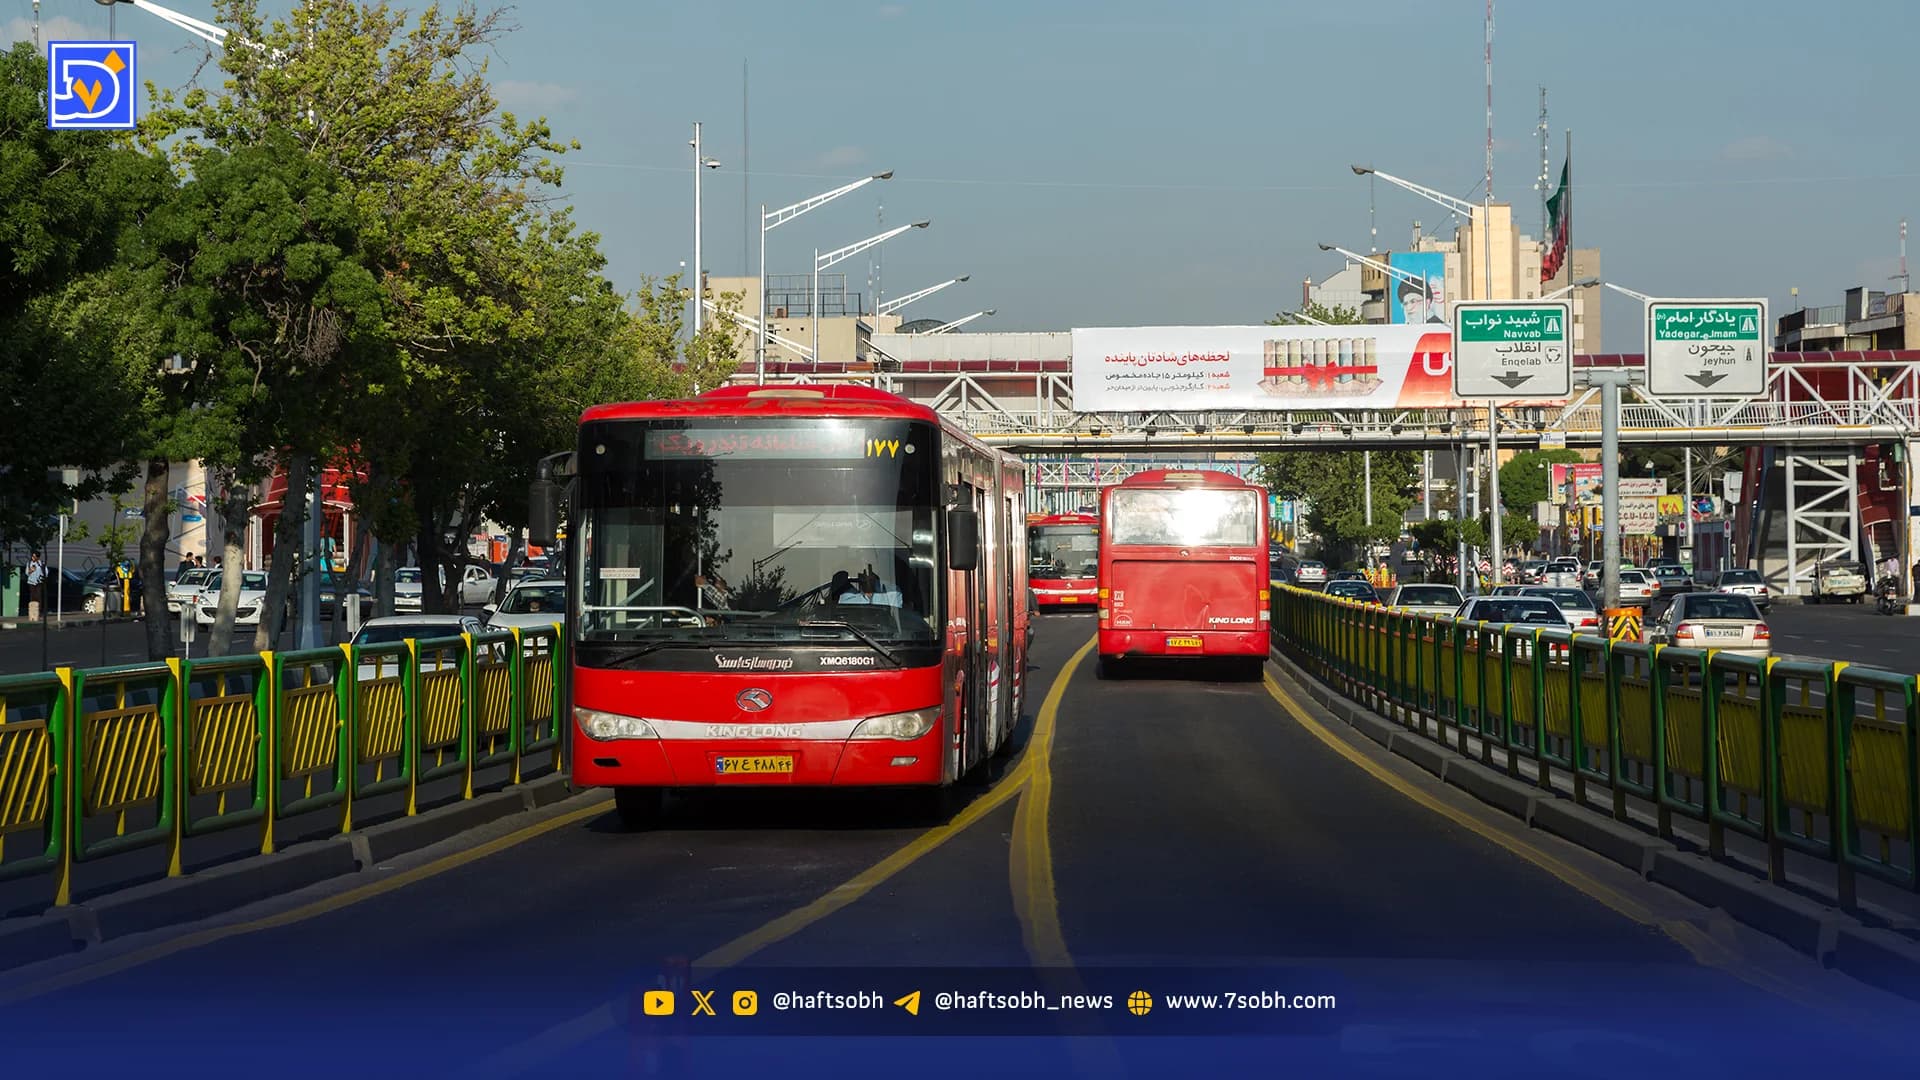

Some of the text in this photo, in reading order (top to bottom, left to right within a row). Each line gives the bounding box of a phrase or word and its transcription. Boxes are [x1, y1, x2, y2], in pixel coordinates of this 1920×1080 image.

[1465, 311, 1541, 331] شهید نواب
[1666, 311, 1693, 329] امام
[1695, 310, 1736, 328] یادگار
[1503, 329, 1541, 338] Navvab
[1495, 341, 1541, 357] انقلاب
[1688, 343, 1735, 357] جیحون
[1105, 373, 1144, 381] مخصوص
[1171, 371, 1204, 380] کیلومتر
[865, 438, 900, 459] ۱۷۷
[819, 656, 875, 666] XMQ6180G1
